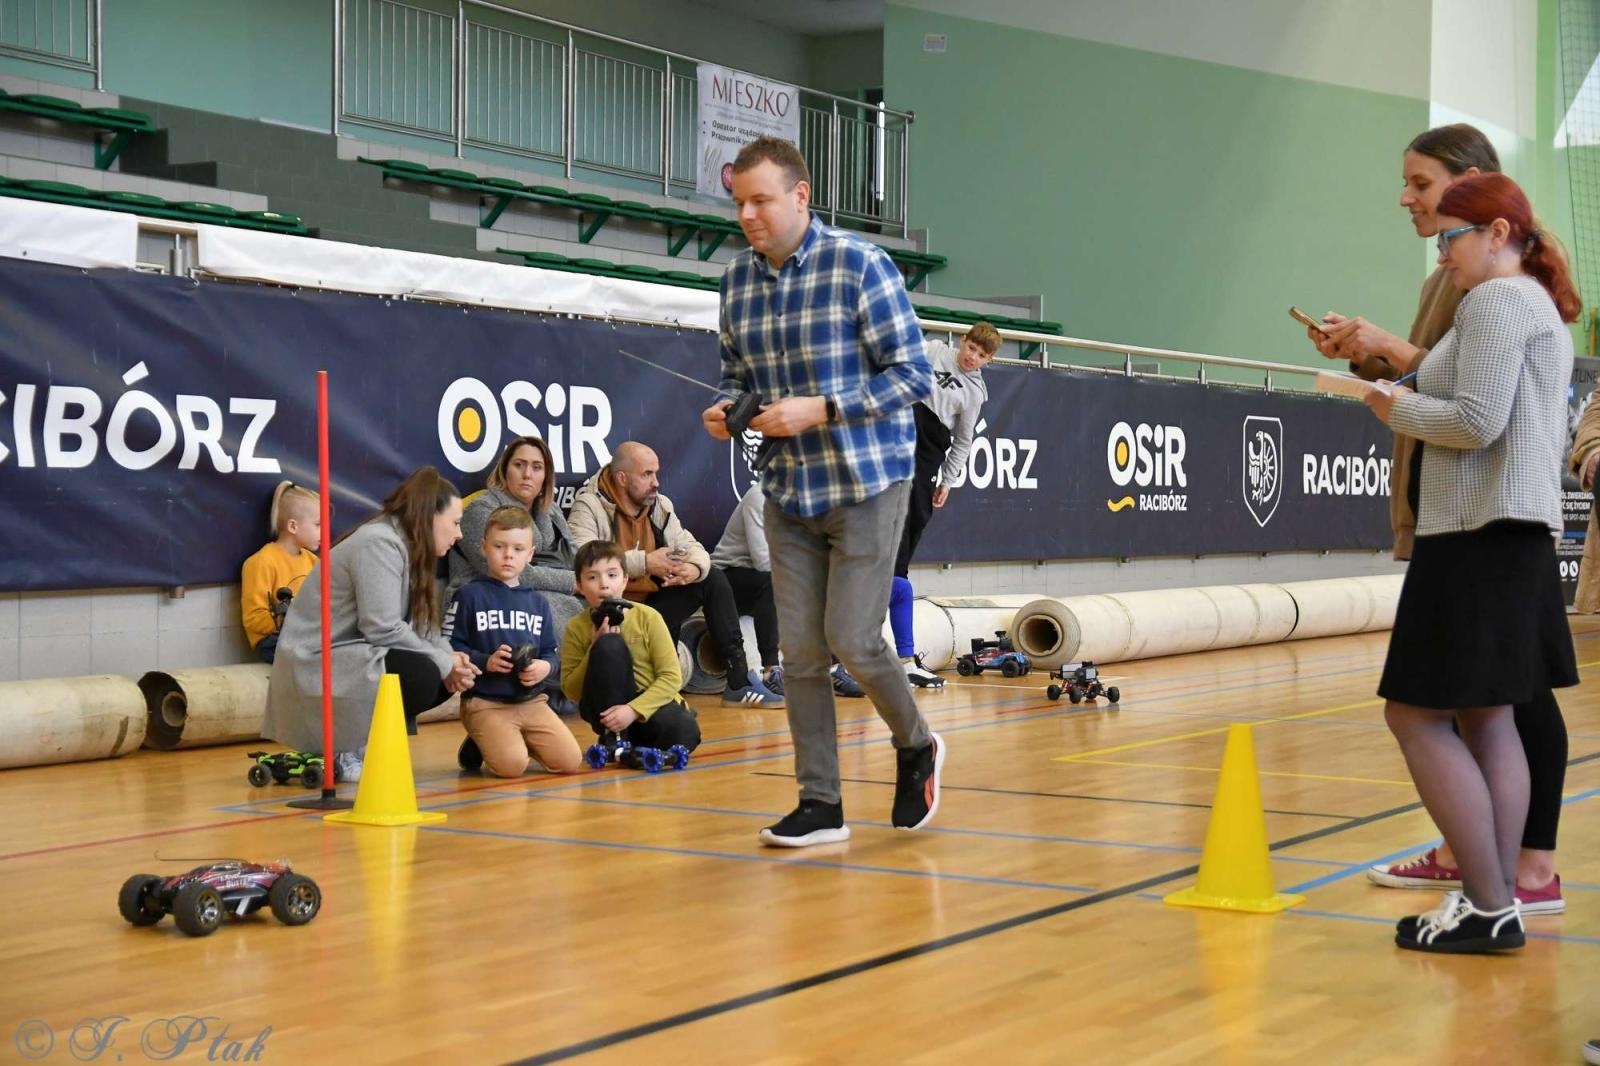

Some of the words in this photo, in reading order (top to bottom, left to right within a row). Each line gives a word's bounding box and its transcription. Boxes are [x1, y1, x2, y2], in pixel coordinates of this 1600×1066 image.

[712, 74, 790, 117] MIESZKO
[0, 360, 282, 474] IBÓRZ
[1303, 443, 1394, 497] RACIBÓR
[1139, 490, 1187, 511] RACIBÓRZ
[475, 609, 544, 636] BELIEVE
